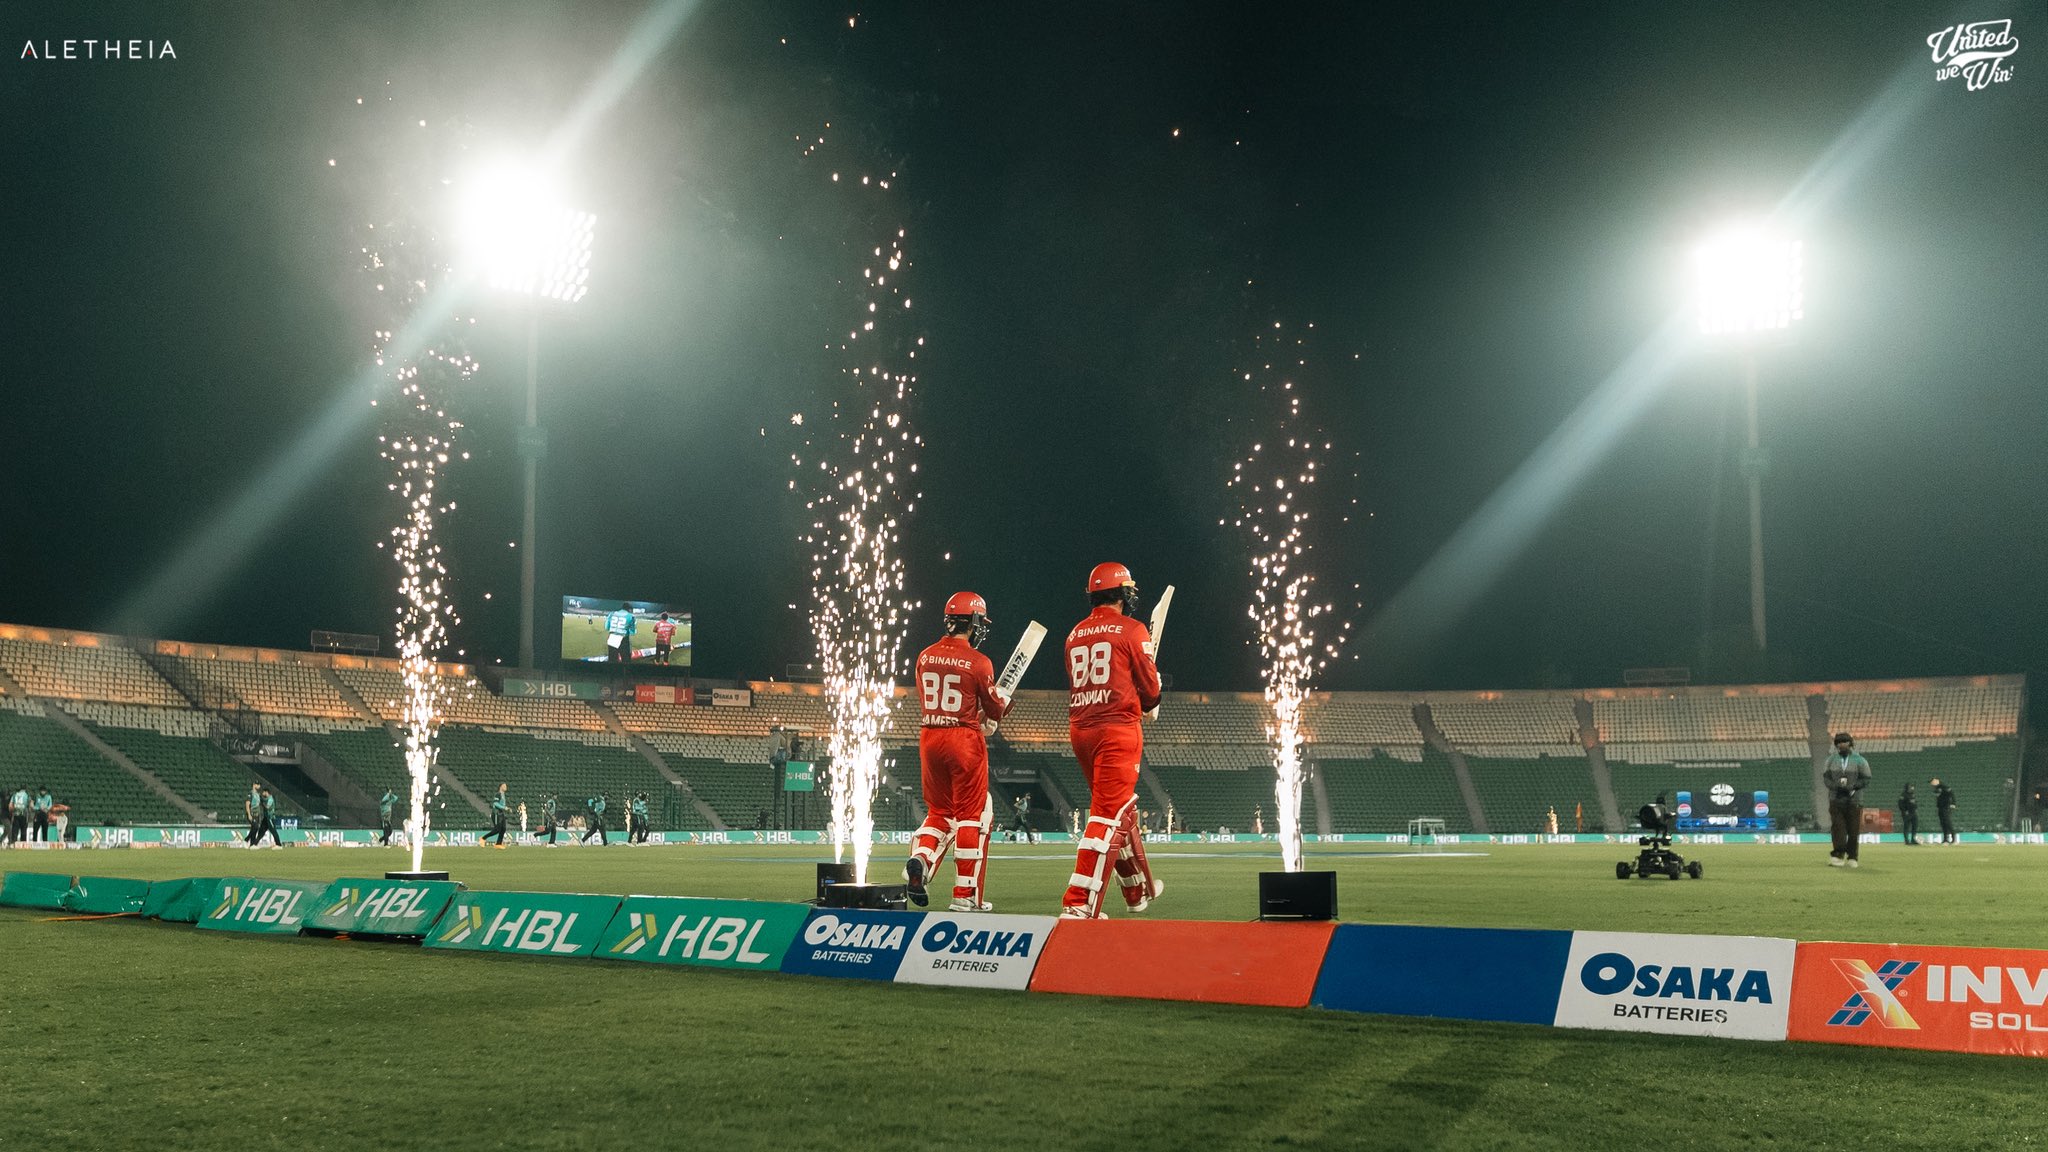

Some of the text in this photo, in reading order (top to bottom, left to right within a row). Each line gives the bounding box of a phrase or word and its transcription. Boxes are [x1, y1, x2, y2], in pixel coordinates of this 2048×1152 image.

[1078, 624, 1123, 638] BINANCE
[928, 655, 972, 670] BINANCE
[1070, 641, 1112, 688] 88
[541, 683, 577, 697] HBL
[922, 671, 962, 712] 86
[794, 772, 813, 780] HBL
[703, 832, 732, 842] HBL
[767, 831, 796, 842] HBL
[892, 831, 915, 842] HB
[235, 887, 303, 925] HBL
[354, 888, 429, 918] HBL
[481, 908, 582, 953] HBL
[658, 915, 770, 964] HBL
[804, 914, 906, 950] OSAKA
[921, 920, 1034, 957] OSAKA
[811, 950, 873, 964] BATTERIES
[932, 958, 999, 973] BATTERIES
[1580, 952, 1772, 1004] OSAKA
[1613, 1004, 1728, 1024] BATTERIES
[1970, 1012, 2048, 1032] SOL
